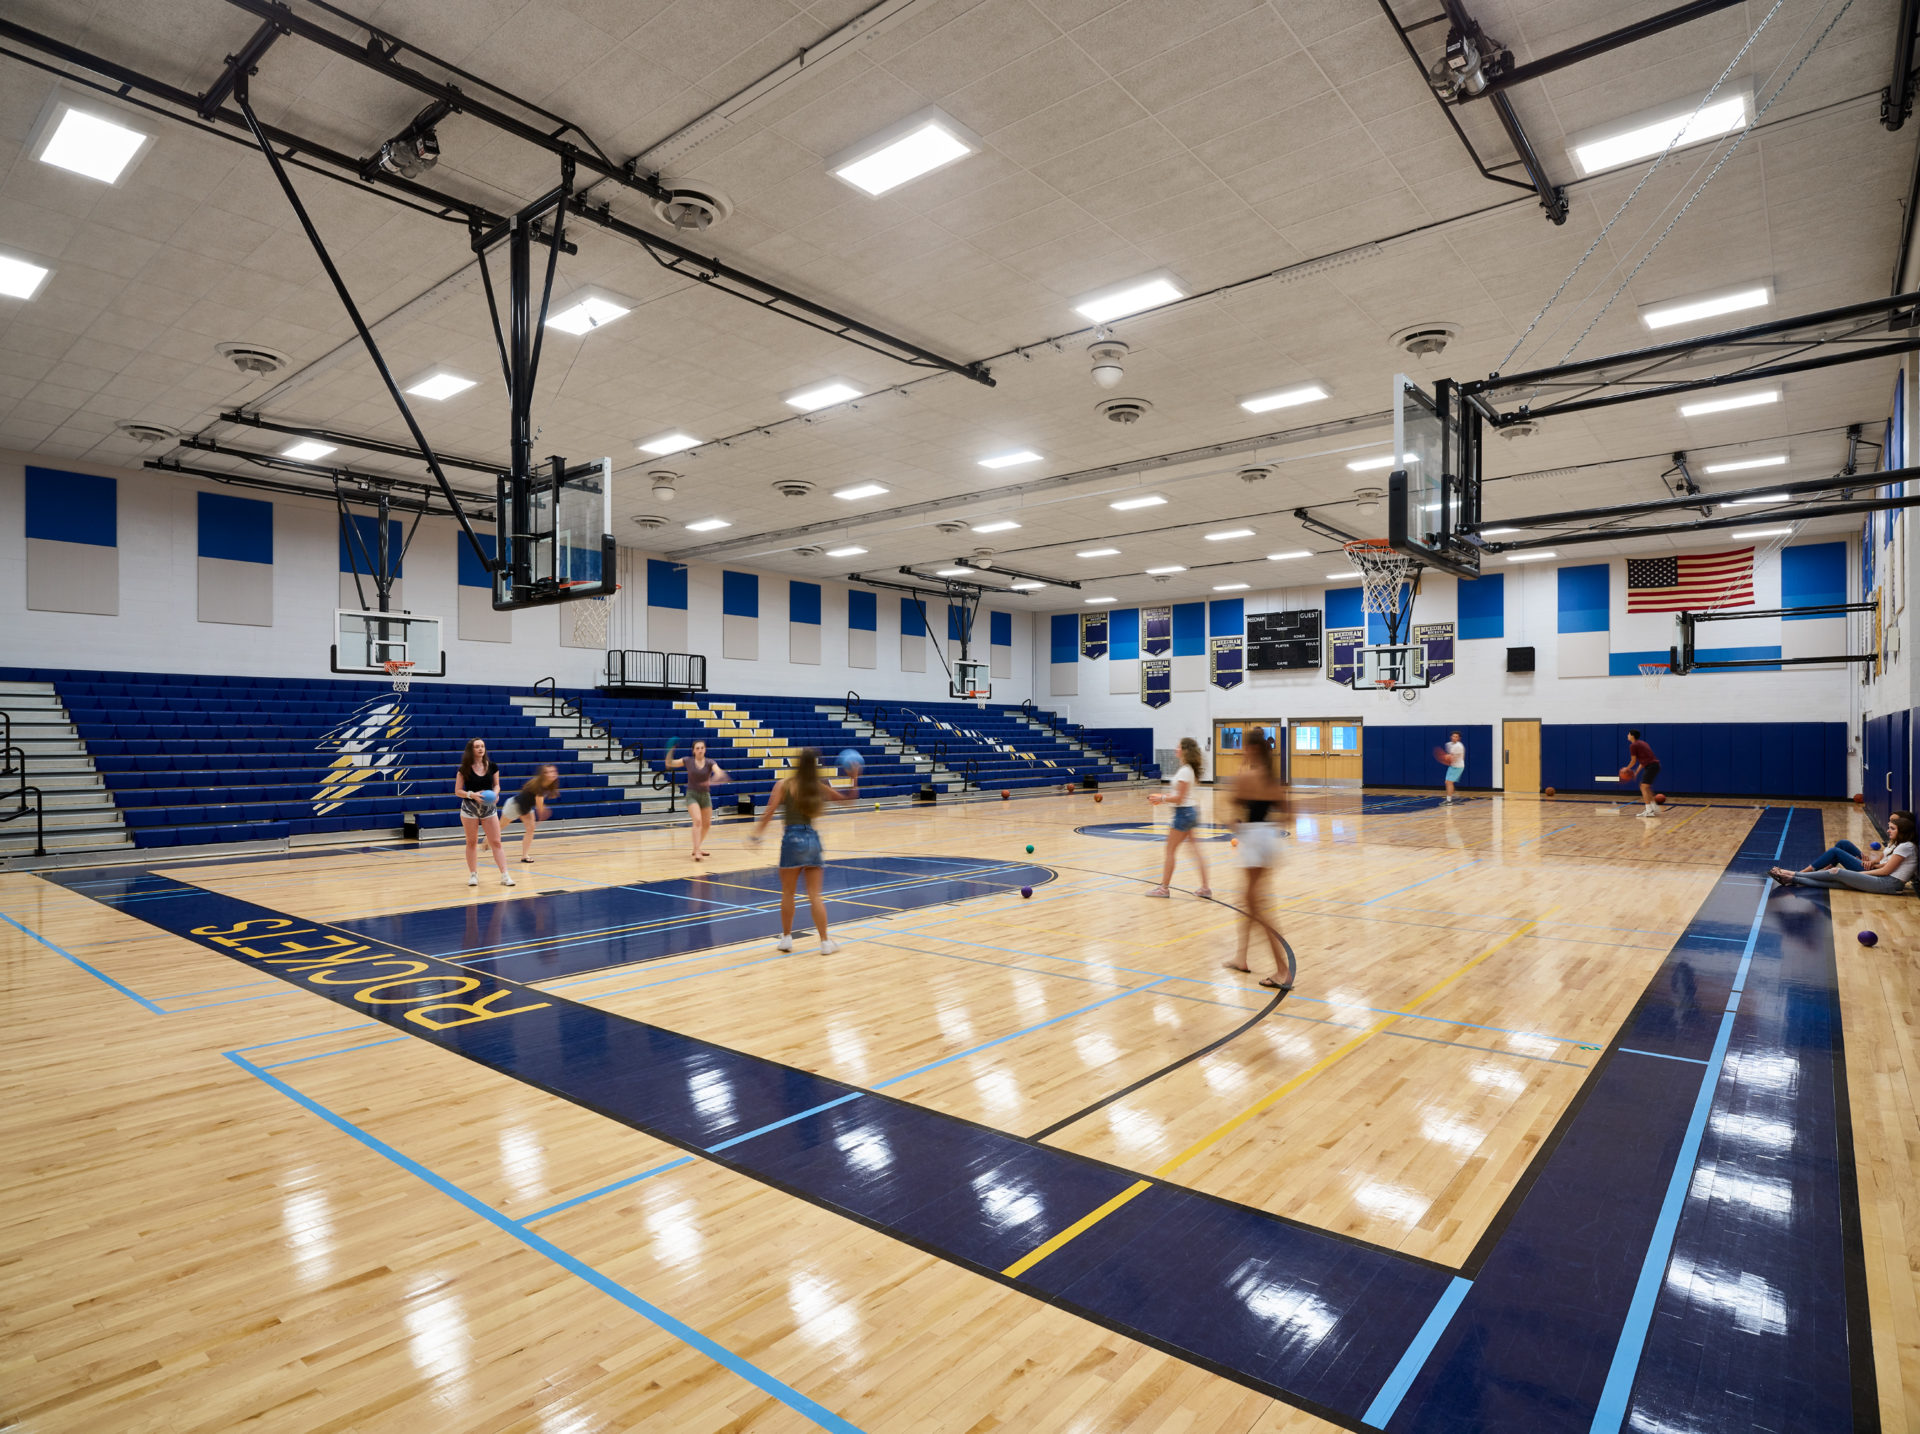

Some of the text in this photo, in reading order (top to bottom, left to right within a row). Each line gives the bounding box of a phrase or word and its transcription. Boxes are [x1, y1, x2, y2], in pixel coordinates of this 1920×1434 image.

[1420, 624, 1452, 633] NEEDHAM
[1333, 630, 1362, 639] NEEDHAM
[1215, 638, 1242, 646] NEEDHAM
[189, 917, 552, 1032] ROCKETS
